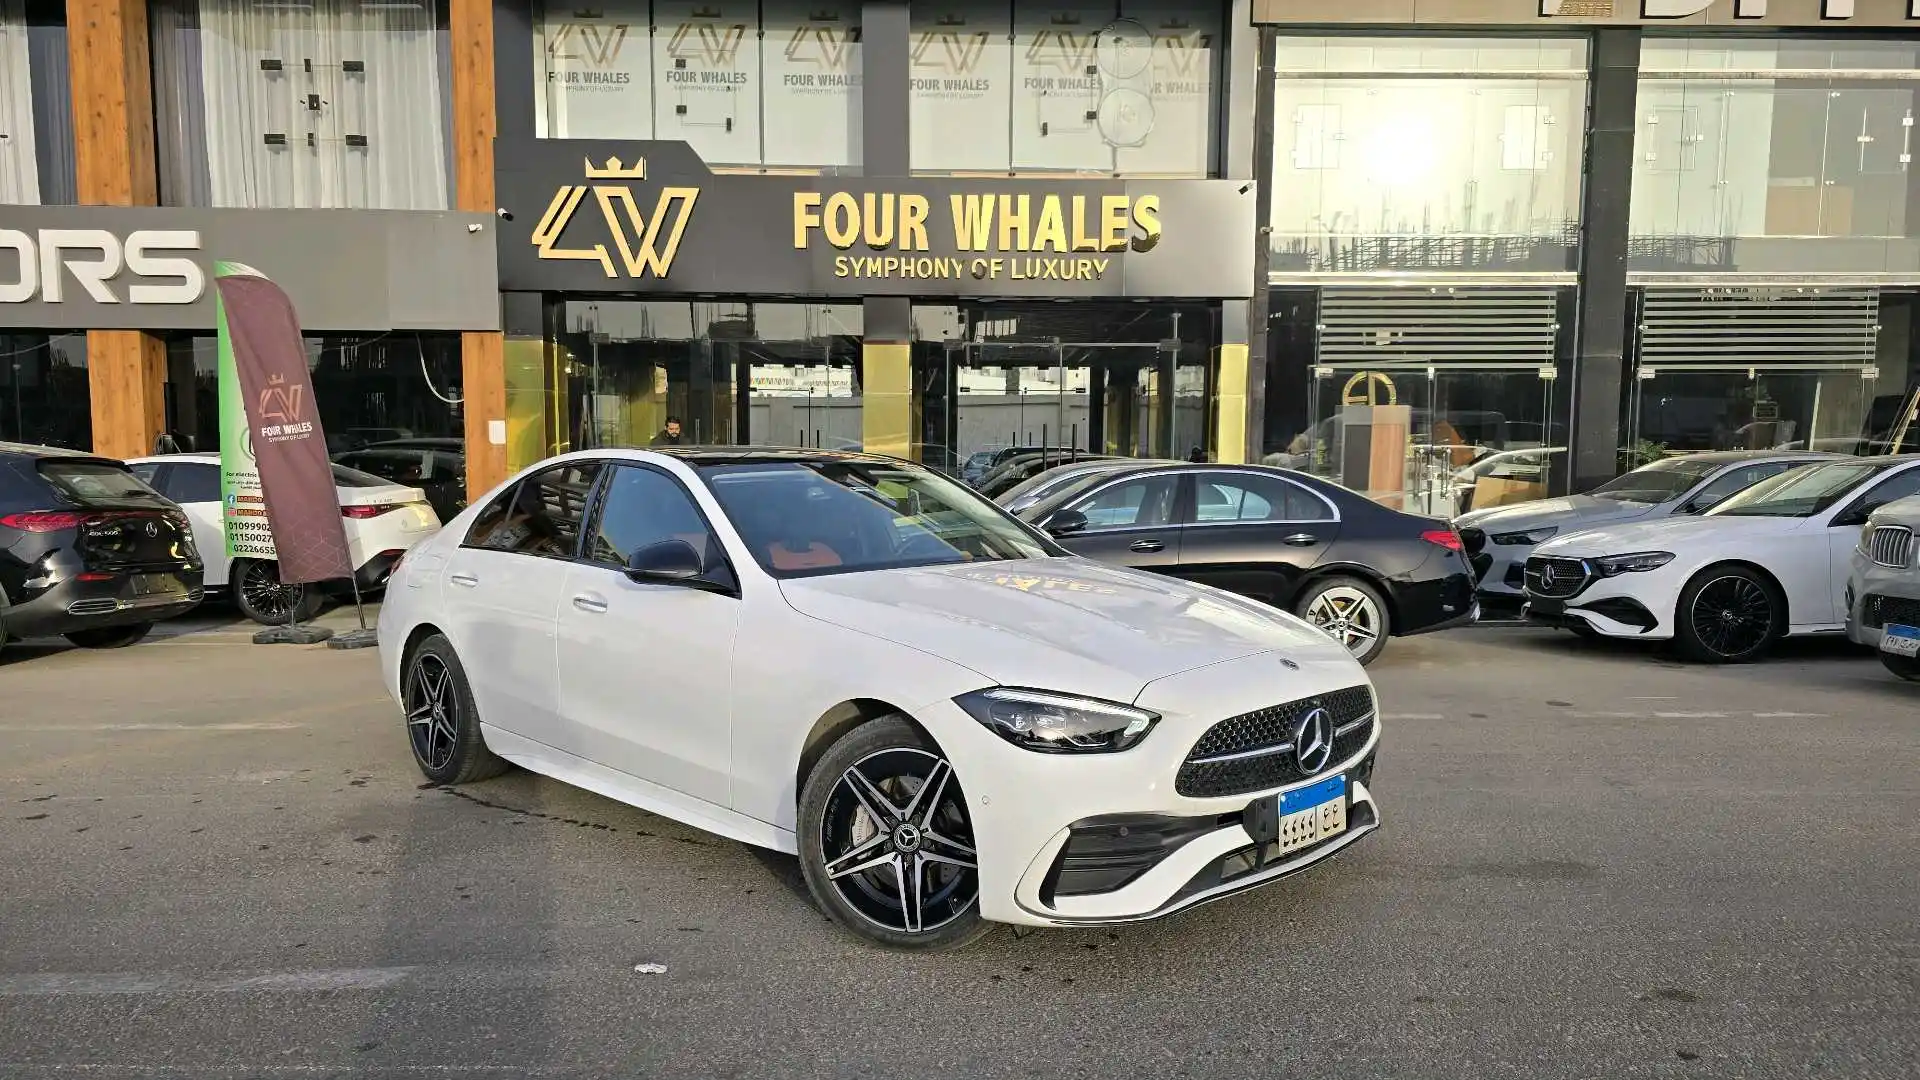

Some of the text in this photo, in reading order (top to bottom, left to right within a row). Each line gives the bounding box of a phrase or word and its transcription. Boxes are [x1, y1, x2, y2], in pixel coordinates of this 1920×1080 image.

[548, 72, 630, 84] FOUR WHALES
[666, 71, 747, 84] FOUR WHALES
[784, 74, 814, 86] FOUR
[1024, 77, 1054, 90] FOUR
[909, 79, 990, 91] FOUR WHALES
[793, 192, 1162, 253] FOUR WHALES
[834, 256, 1109, 281] SYMPHONY OF LUXURY
[261, 421, 313, 438] FOUR WHALES
[229, 533, 272, 543] 01150027
[233, 544, 276, 555] 02226655
